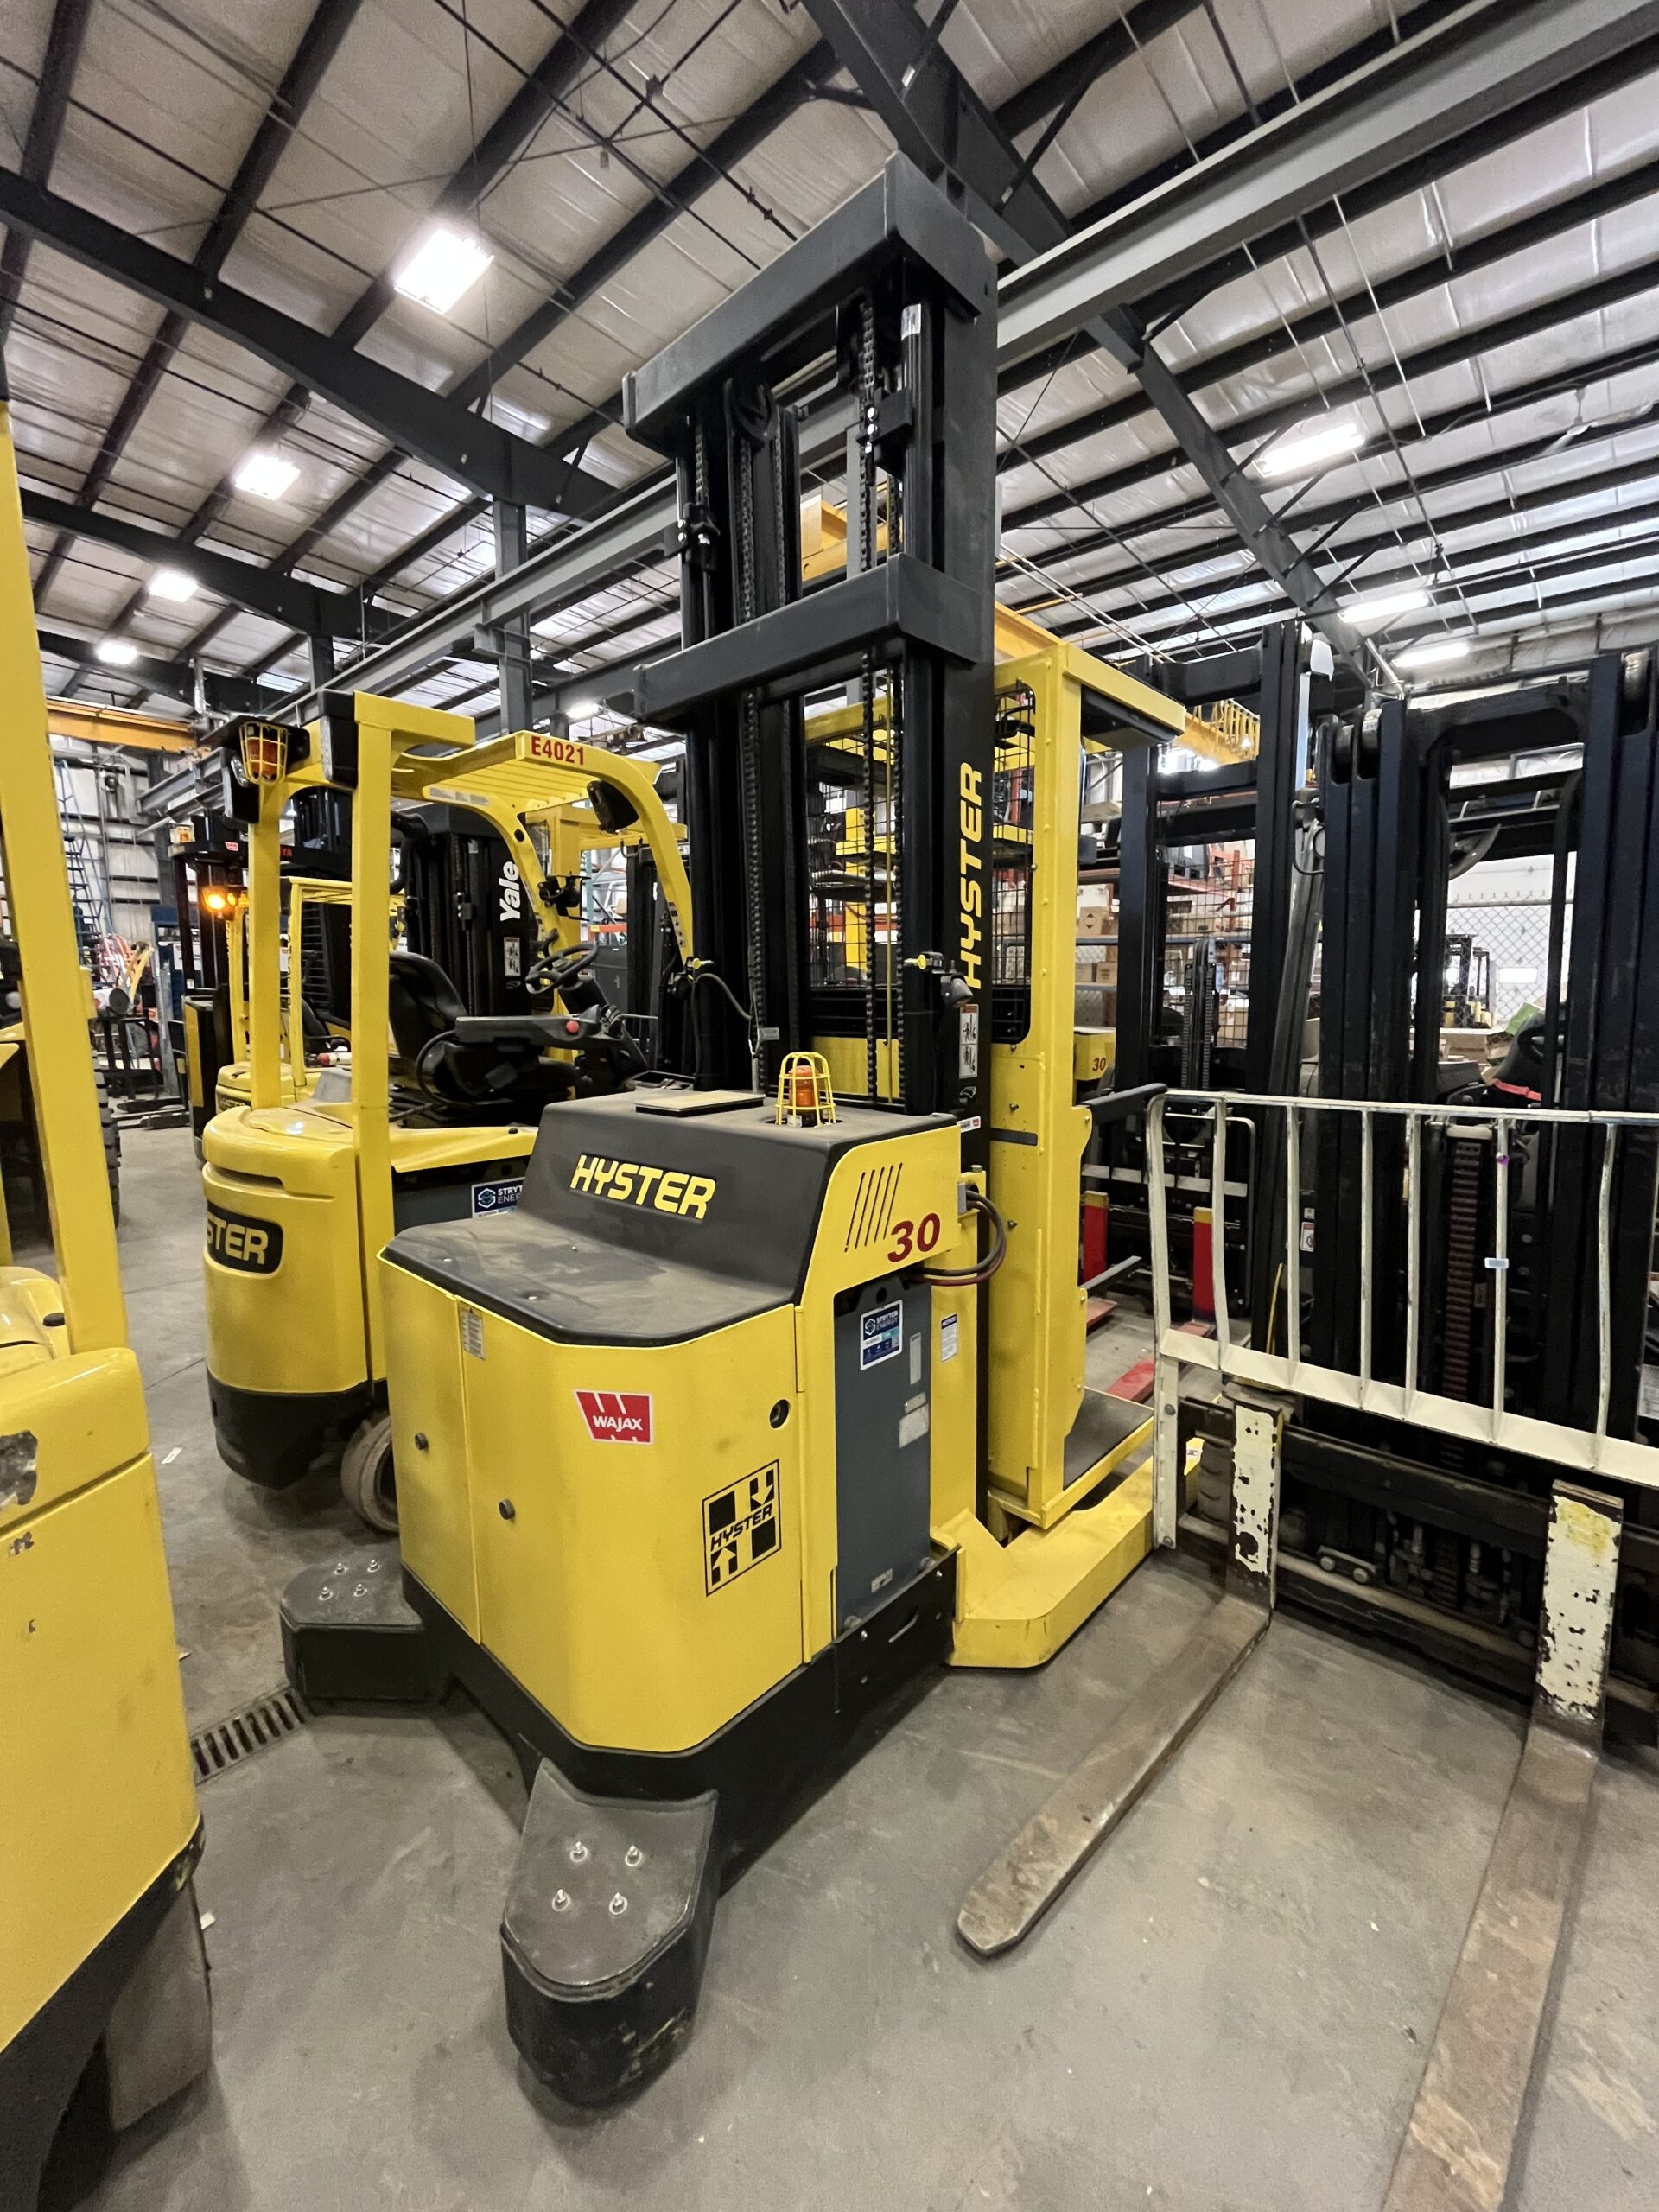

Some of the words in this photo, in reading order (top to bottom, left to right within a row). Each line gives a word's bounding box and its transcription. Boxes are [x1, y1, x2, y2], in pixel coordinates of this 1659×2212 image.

[531, 736, 584, 766] E4021
[499, 861, 521, 922] Yale
[960, 762, 982, 990] HYSTER
[1092, 1057, 1107, 1071] 30
[498, 1185, 524, 1196] STRYT
[569, 1154, 717, 1220] HYSTER
[207, 1211, 268, 1265] TER
[887, 1212, 941, 1263] 30
[593, 1415, 643, 1432] WAJAX
[710, 1503, 772, 1552] HYSTER
